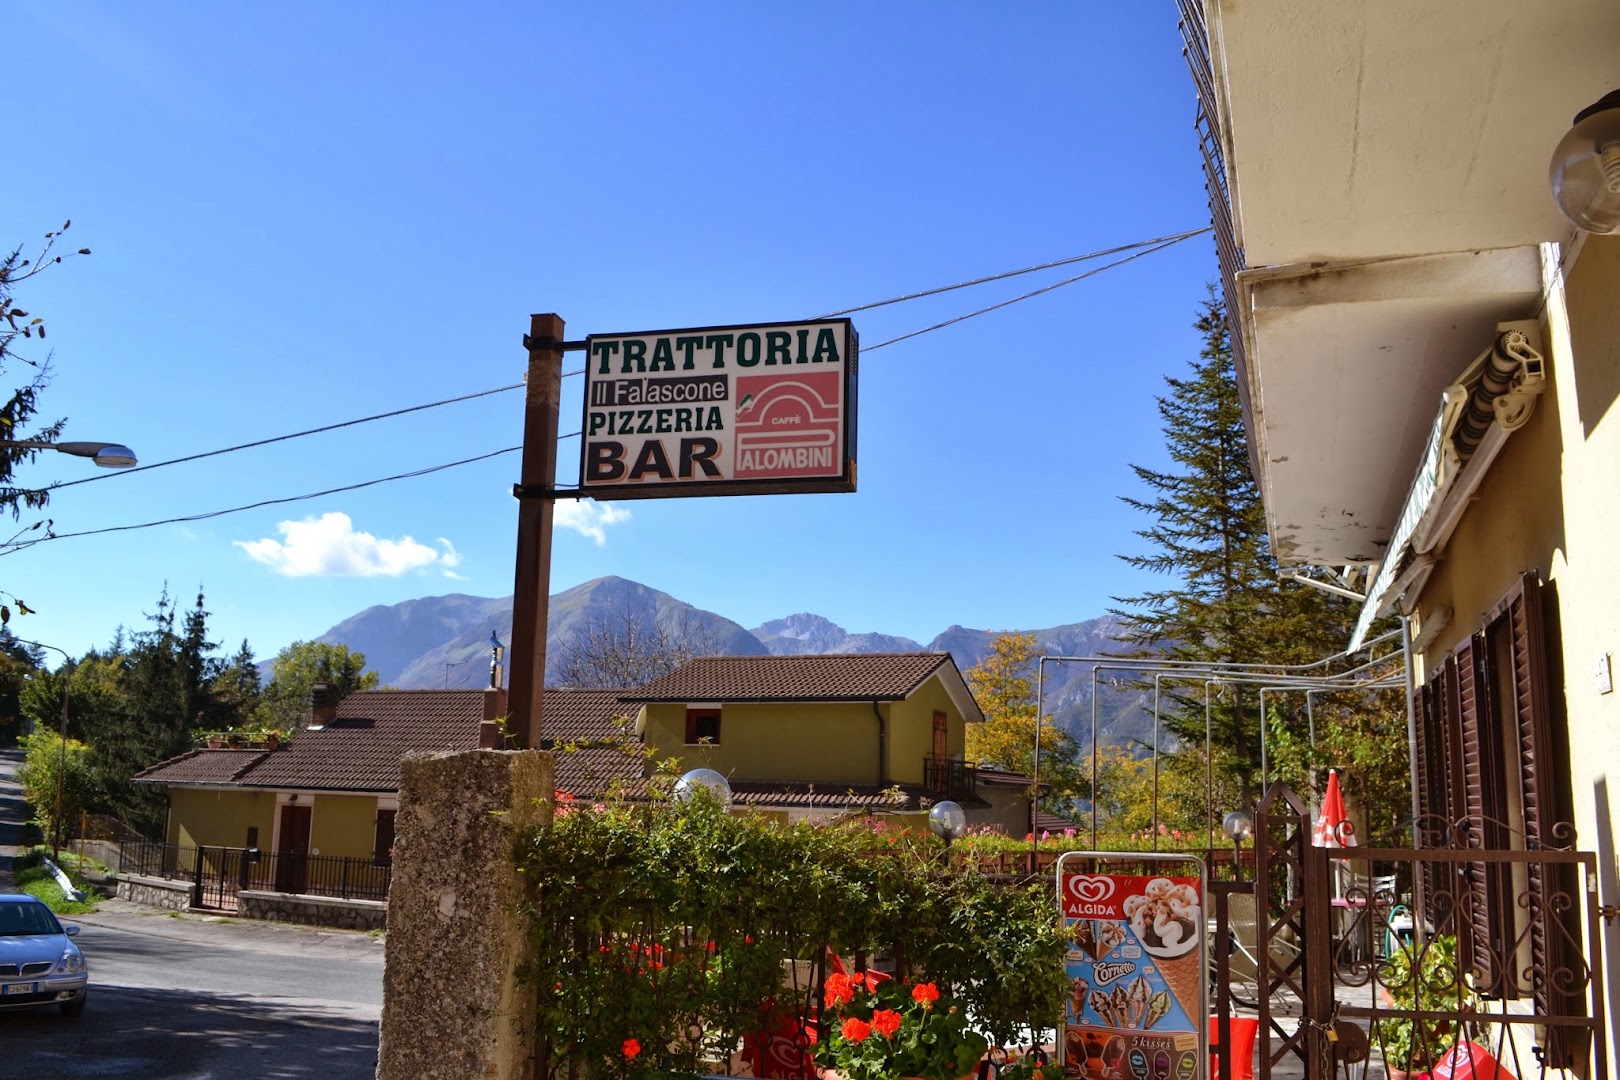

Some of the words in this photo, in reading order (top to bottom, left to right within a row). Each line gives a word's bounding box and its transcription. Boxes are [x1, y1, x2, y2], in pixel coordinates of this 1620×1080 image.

[592, 328, 840, 375] TRATTORIA
[595, 382, 608, 405] Il
[616, 379, 726, 405] Falascone
[588, 406, 724, 436] PIZZERIA
[771, 414, 802, 425] CAFFÈ
[586, 437, 725, 485] BAR
[1068, 904, 1115, 916] ALGIDA
[1092, 962, 1136, 987] Cornetto
[1131, 1036, 1139, 1047] 5
[1140, 1036, 1171, 1048] kisses
